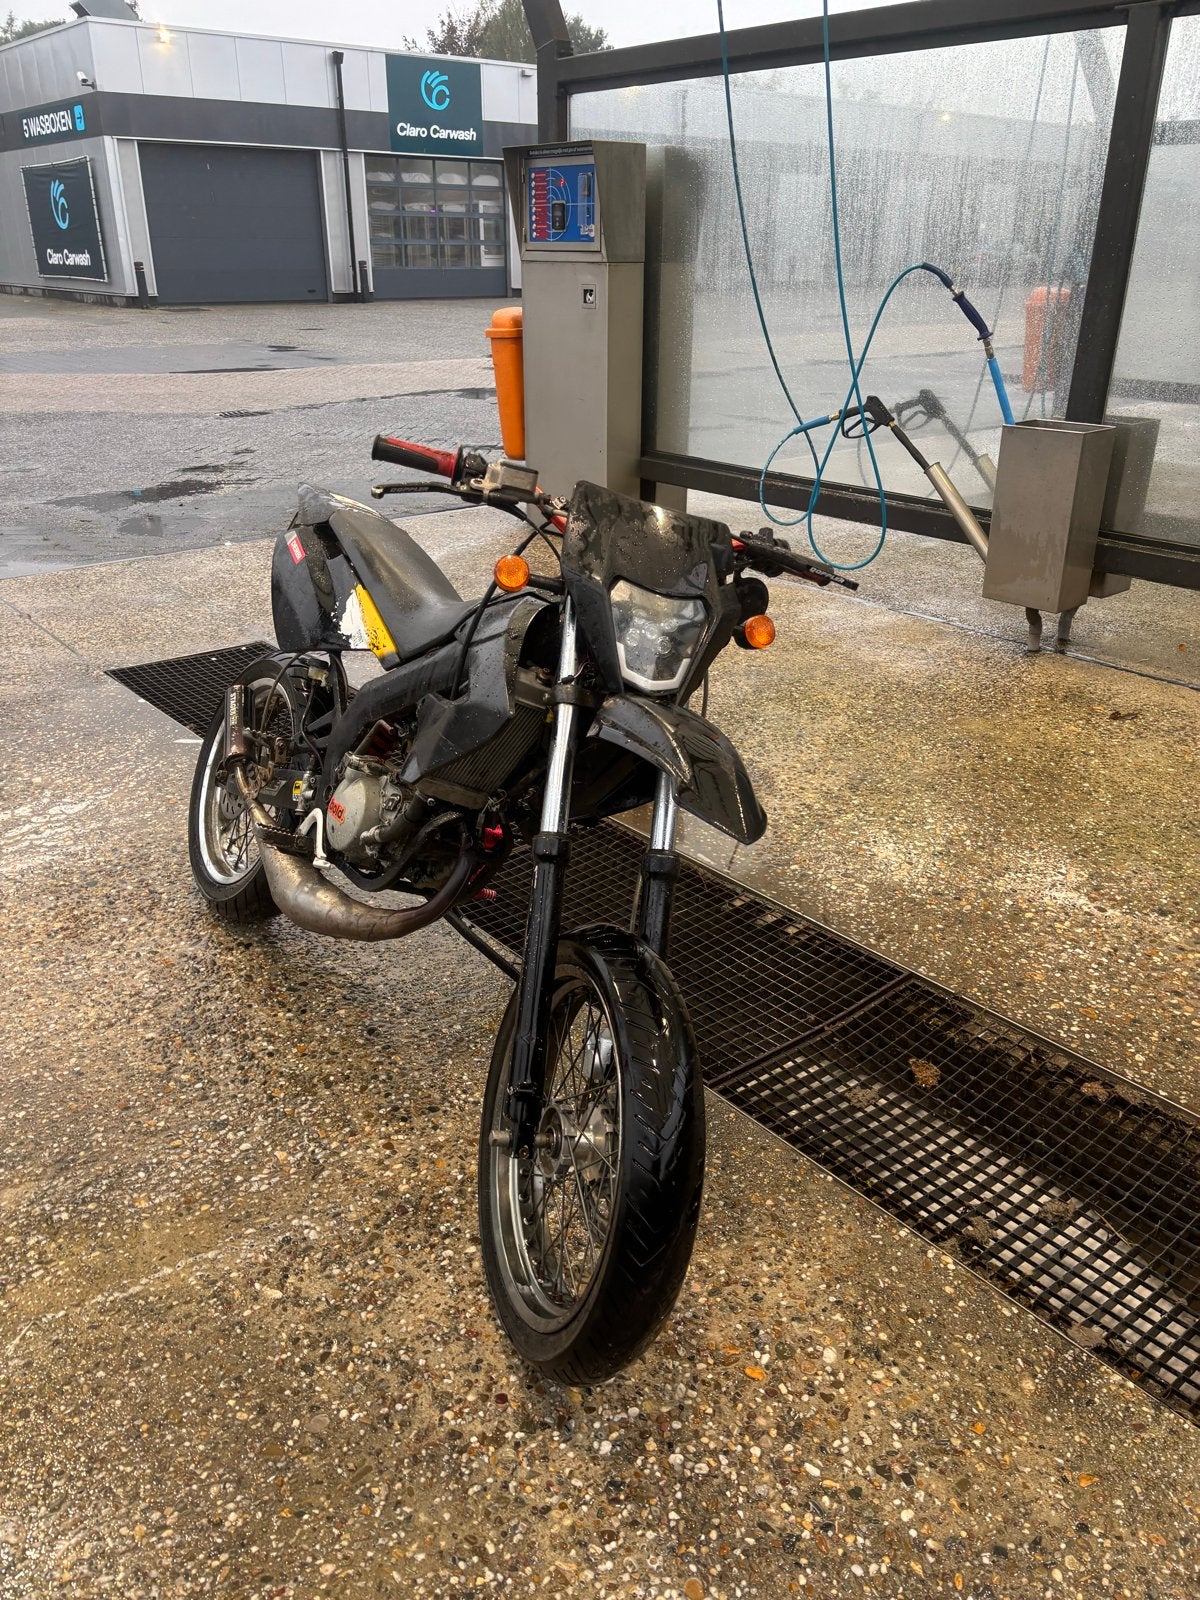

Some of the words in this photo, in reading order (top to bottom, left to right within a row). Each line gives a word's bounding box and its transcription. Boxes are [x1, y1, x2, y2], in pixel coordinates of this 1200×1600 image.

[22, 119, 29, 138] 5
[29, 110, 73, 138] WASBOXEN
[396, 122, 428, 138] Claro
[429, 124, 477, 141] Carwash
[46, 248, 64, 266] Claro
[63, 249, 91, 267] Carwash
